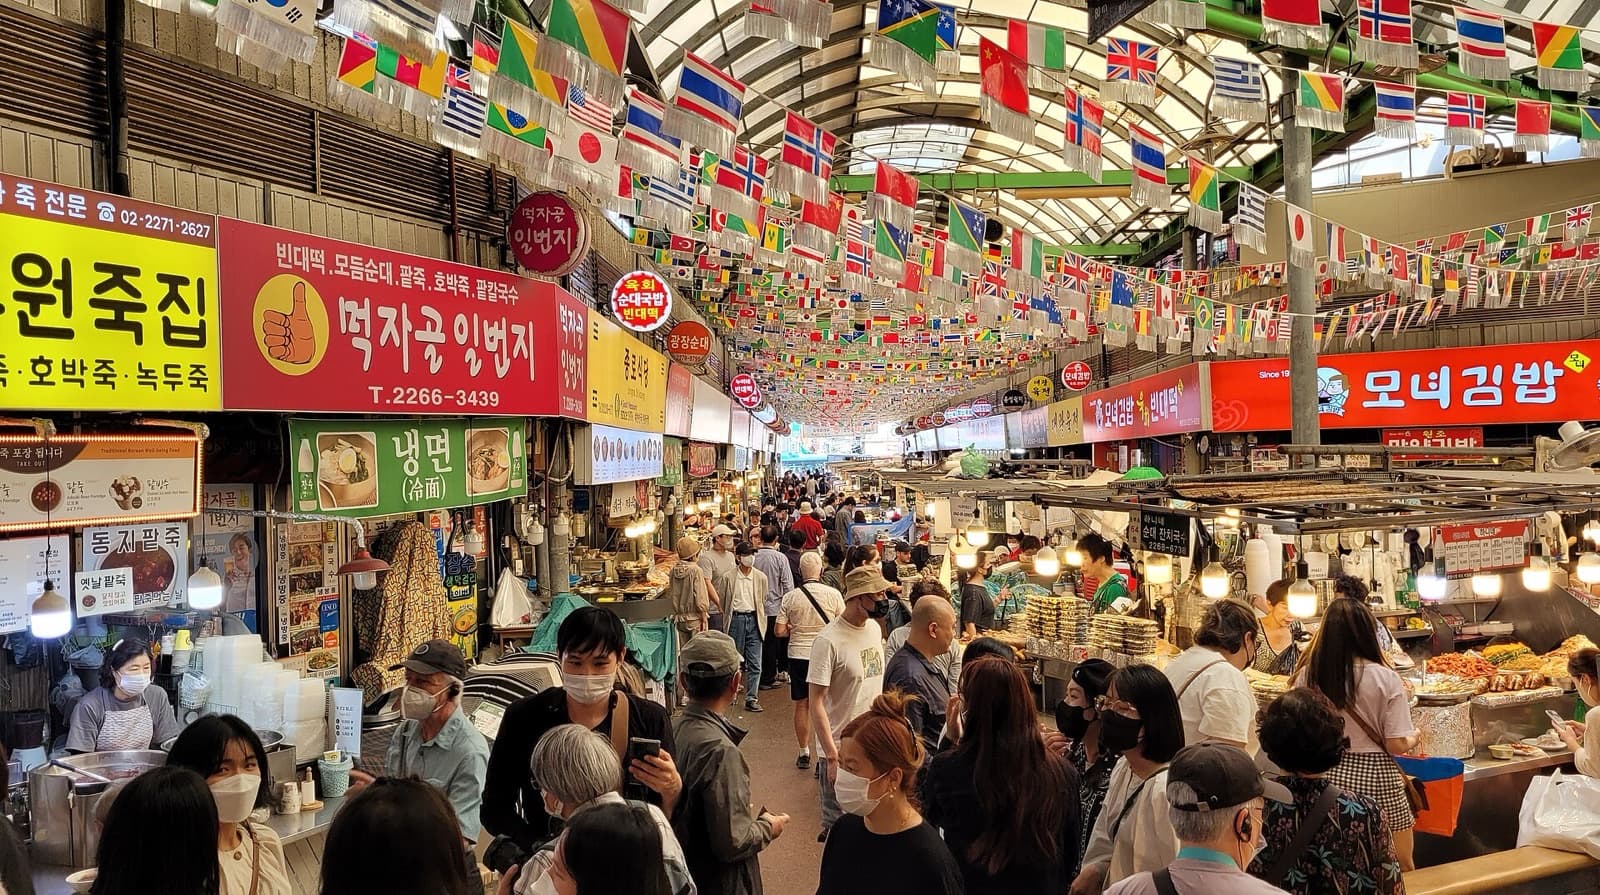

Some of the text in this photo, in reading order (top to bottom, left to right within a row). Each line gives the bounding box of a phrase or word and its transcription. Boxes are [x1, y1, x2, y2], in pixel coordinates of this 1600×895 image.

[14, 182, 211, 239] 죽 전문 02-2271-2627
[522, 206, 566, 222] 먹자골
[514, 227, 572, 254] 일번지
[625, 279, 656, 290] 육회
[0, 252, 207, 349] 원죽집
[617, 293, 665, 306] 순대국밥
[623, 307, 659, 320] 빈대떡
[560, 302, 584, 351] 먹자골
[670, 334, 709, 350] 광장순대
[561, 349, 584, 393] 일번지
[623, 347, 649, 388] 종로식당
[1258, 370, 1290, 379] Since 19
[1361, 360, 1564, 409] 모녀김밥
[368, 386, 499, 407] T.2266-3439
[1105, 395, 1134, 428] 모녀김밥
[1150, 385, 1178, 422] 빈대떡
[1423, 429, 1447, 439] 원조
[12, 447, 33, 459] 포장
[35, 446, 64, 459] 됩니다
[392, 427, 452, 477] 냉면
[66, 481, 85, 494] 팥죽
[402, 474, 447, 504] (冷面)
[91, 526, 181, 555] 동지팥죽
[1143, 525, 1186, 544] 순대 잔치국수
[446, 553, 474, 575] 장수
[80, 573, 127, 591] 옛날 팥죽
